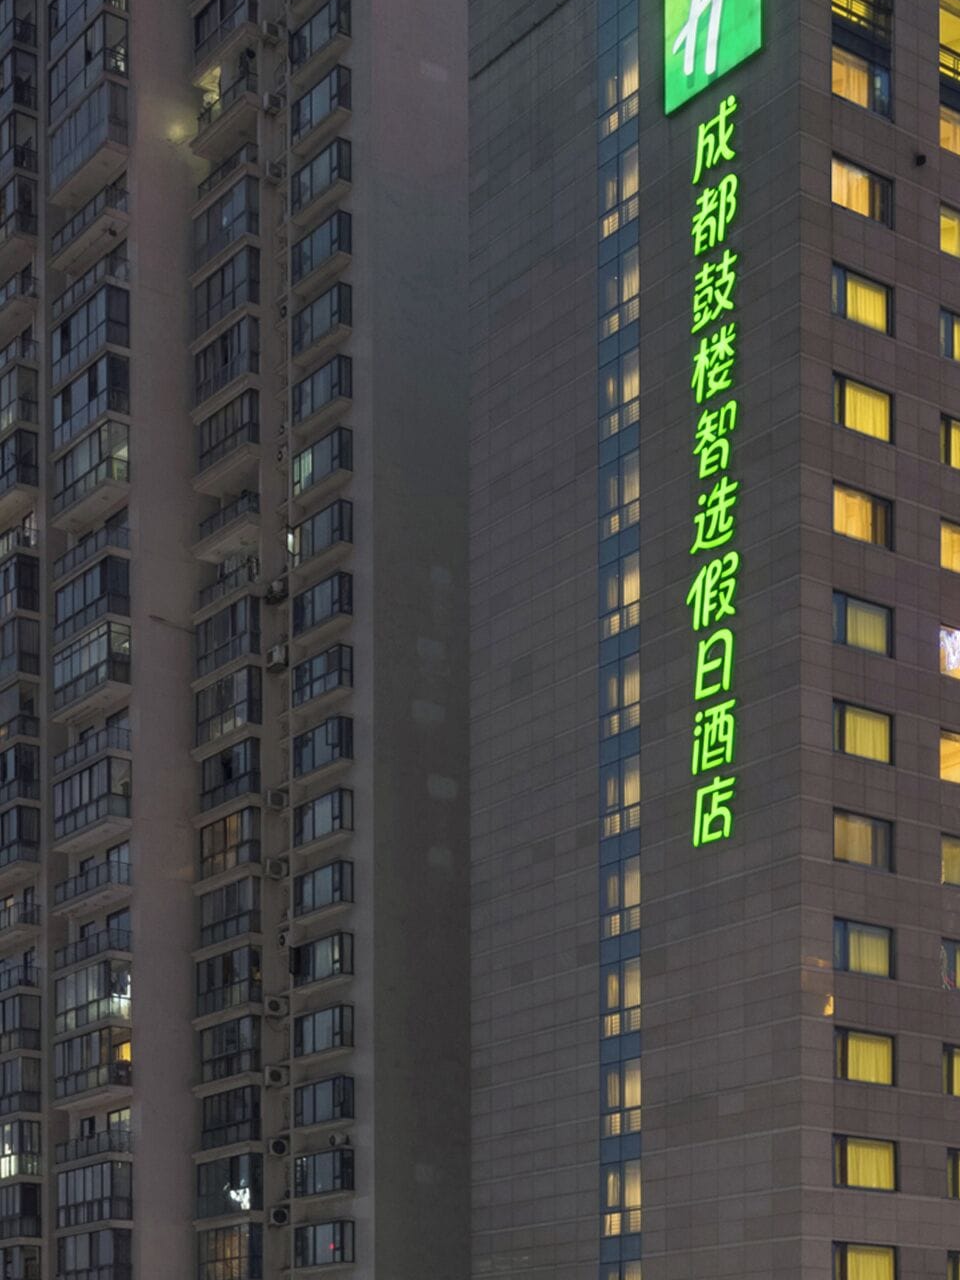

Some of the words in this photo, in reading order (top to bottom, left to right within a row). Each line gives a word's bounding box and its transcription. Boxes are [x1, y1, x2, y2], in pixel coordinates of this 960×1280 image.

[686, 94, 739, 848] 成都鼓楼智选假日酒店
